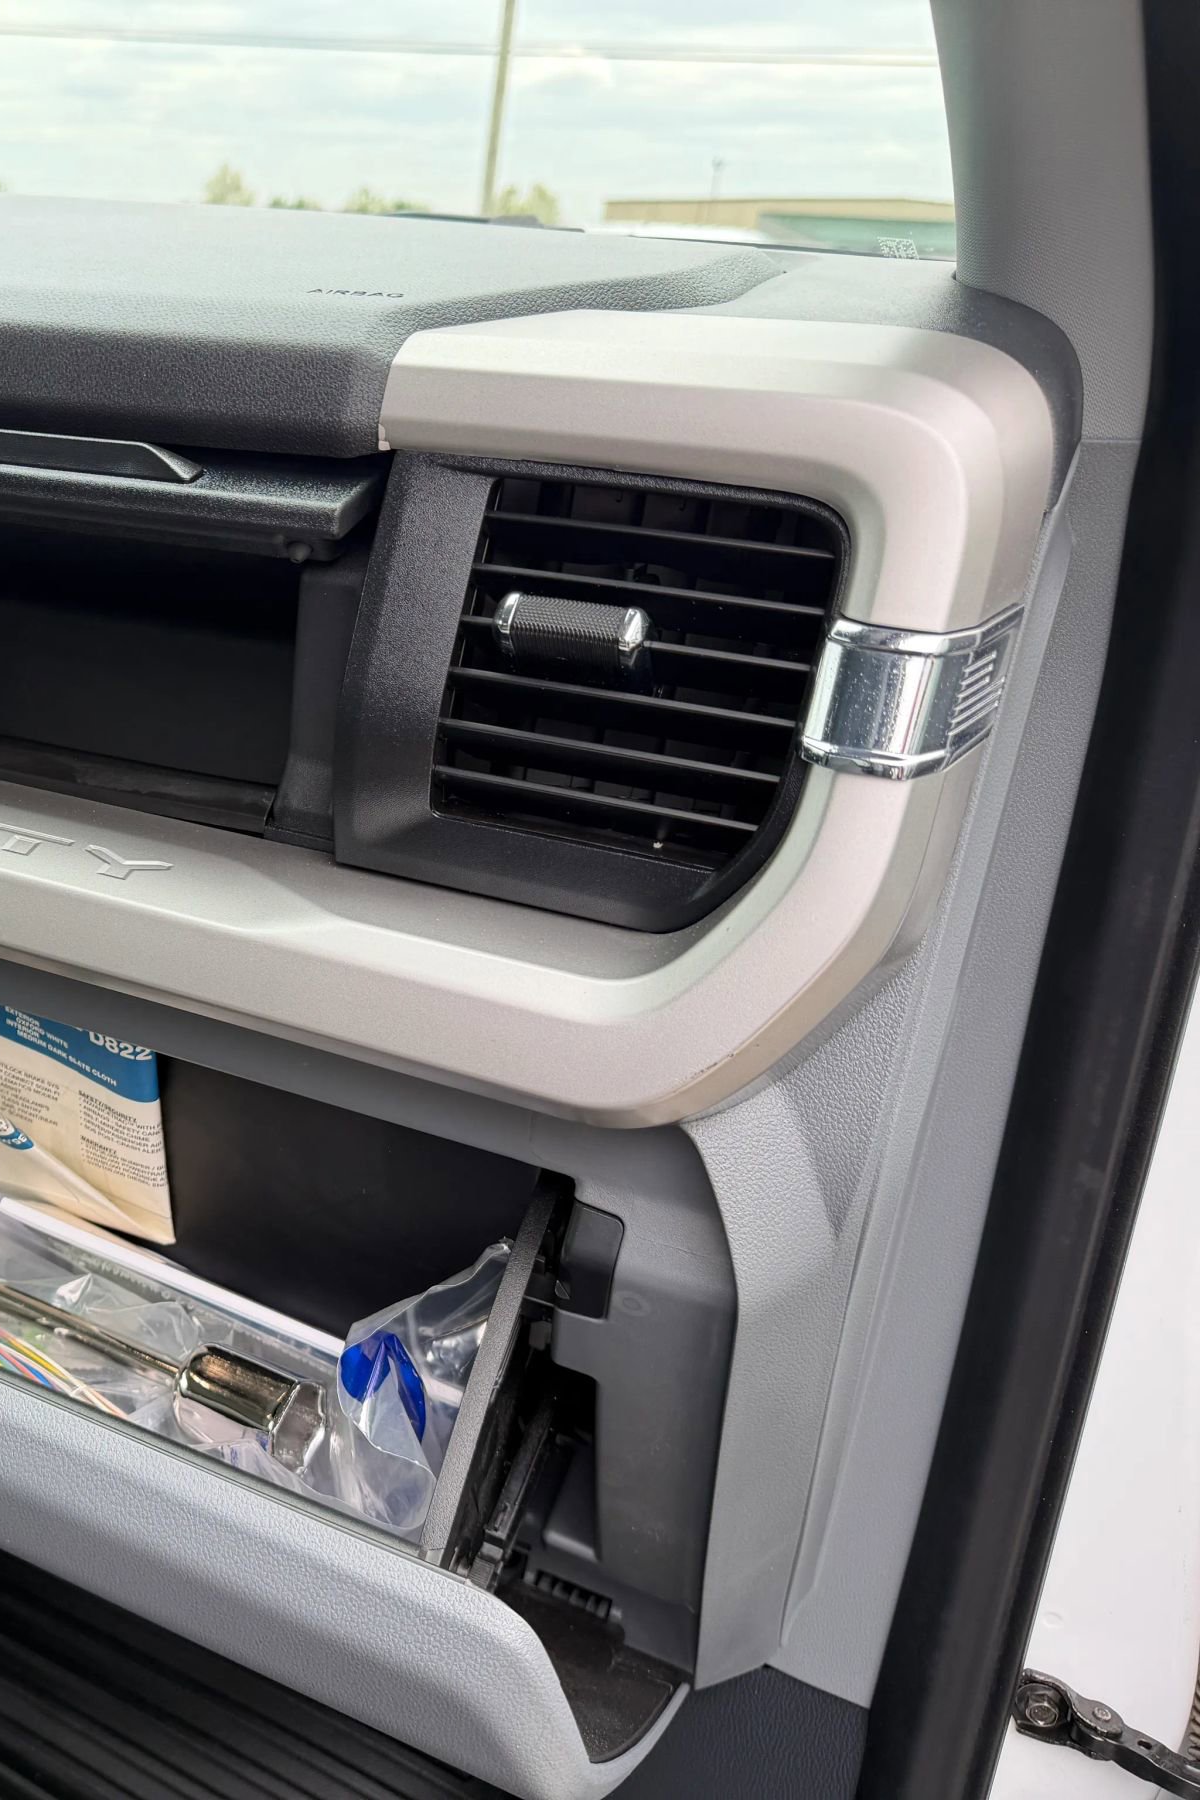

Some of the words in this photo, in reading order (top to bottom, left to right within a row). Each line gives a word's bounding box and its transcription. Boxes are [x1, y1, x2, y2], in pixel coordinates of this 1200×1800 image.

[306, 287, 404, 299] AIRBAG
[4, 1006, 40, 1026] EXTERIOR
[5, 1018, 40, 1038] INTERIOR
[16, 1017, 45, 1034] OXFORD
[46, 1032, 68, 1049] WHITE
[16, 1030, 47, 1049] MEDIUM
[47, 1043, 68, 1059] DARK
[68, 1055, 91, 1073] SLATE
[91, 1068, 117, 1087] CLOTH
[4, 1069, 33, 1086] CONNECT
[23, 1070, 44, 1084] BRAKE
[10, 1090, 49, 1112] HEADLAMPS
[33, 1087, 58, 1102] MODEM
[78, 1090, 136, 1124] SAFETY/SECURITY
[114, 1120, 138, 1136] SAFETY
[98, 1129, 140, 1152] POST-CRASH
